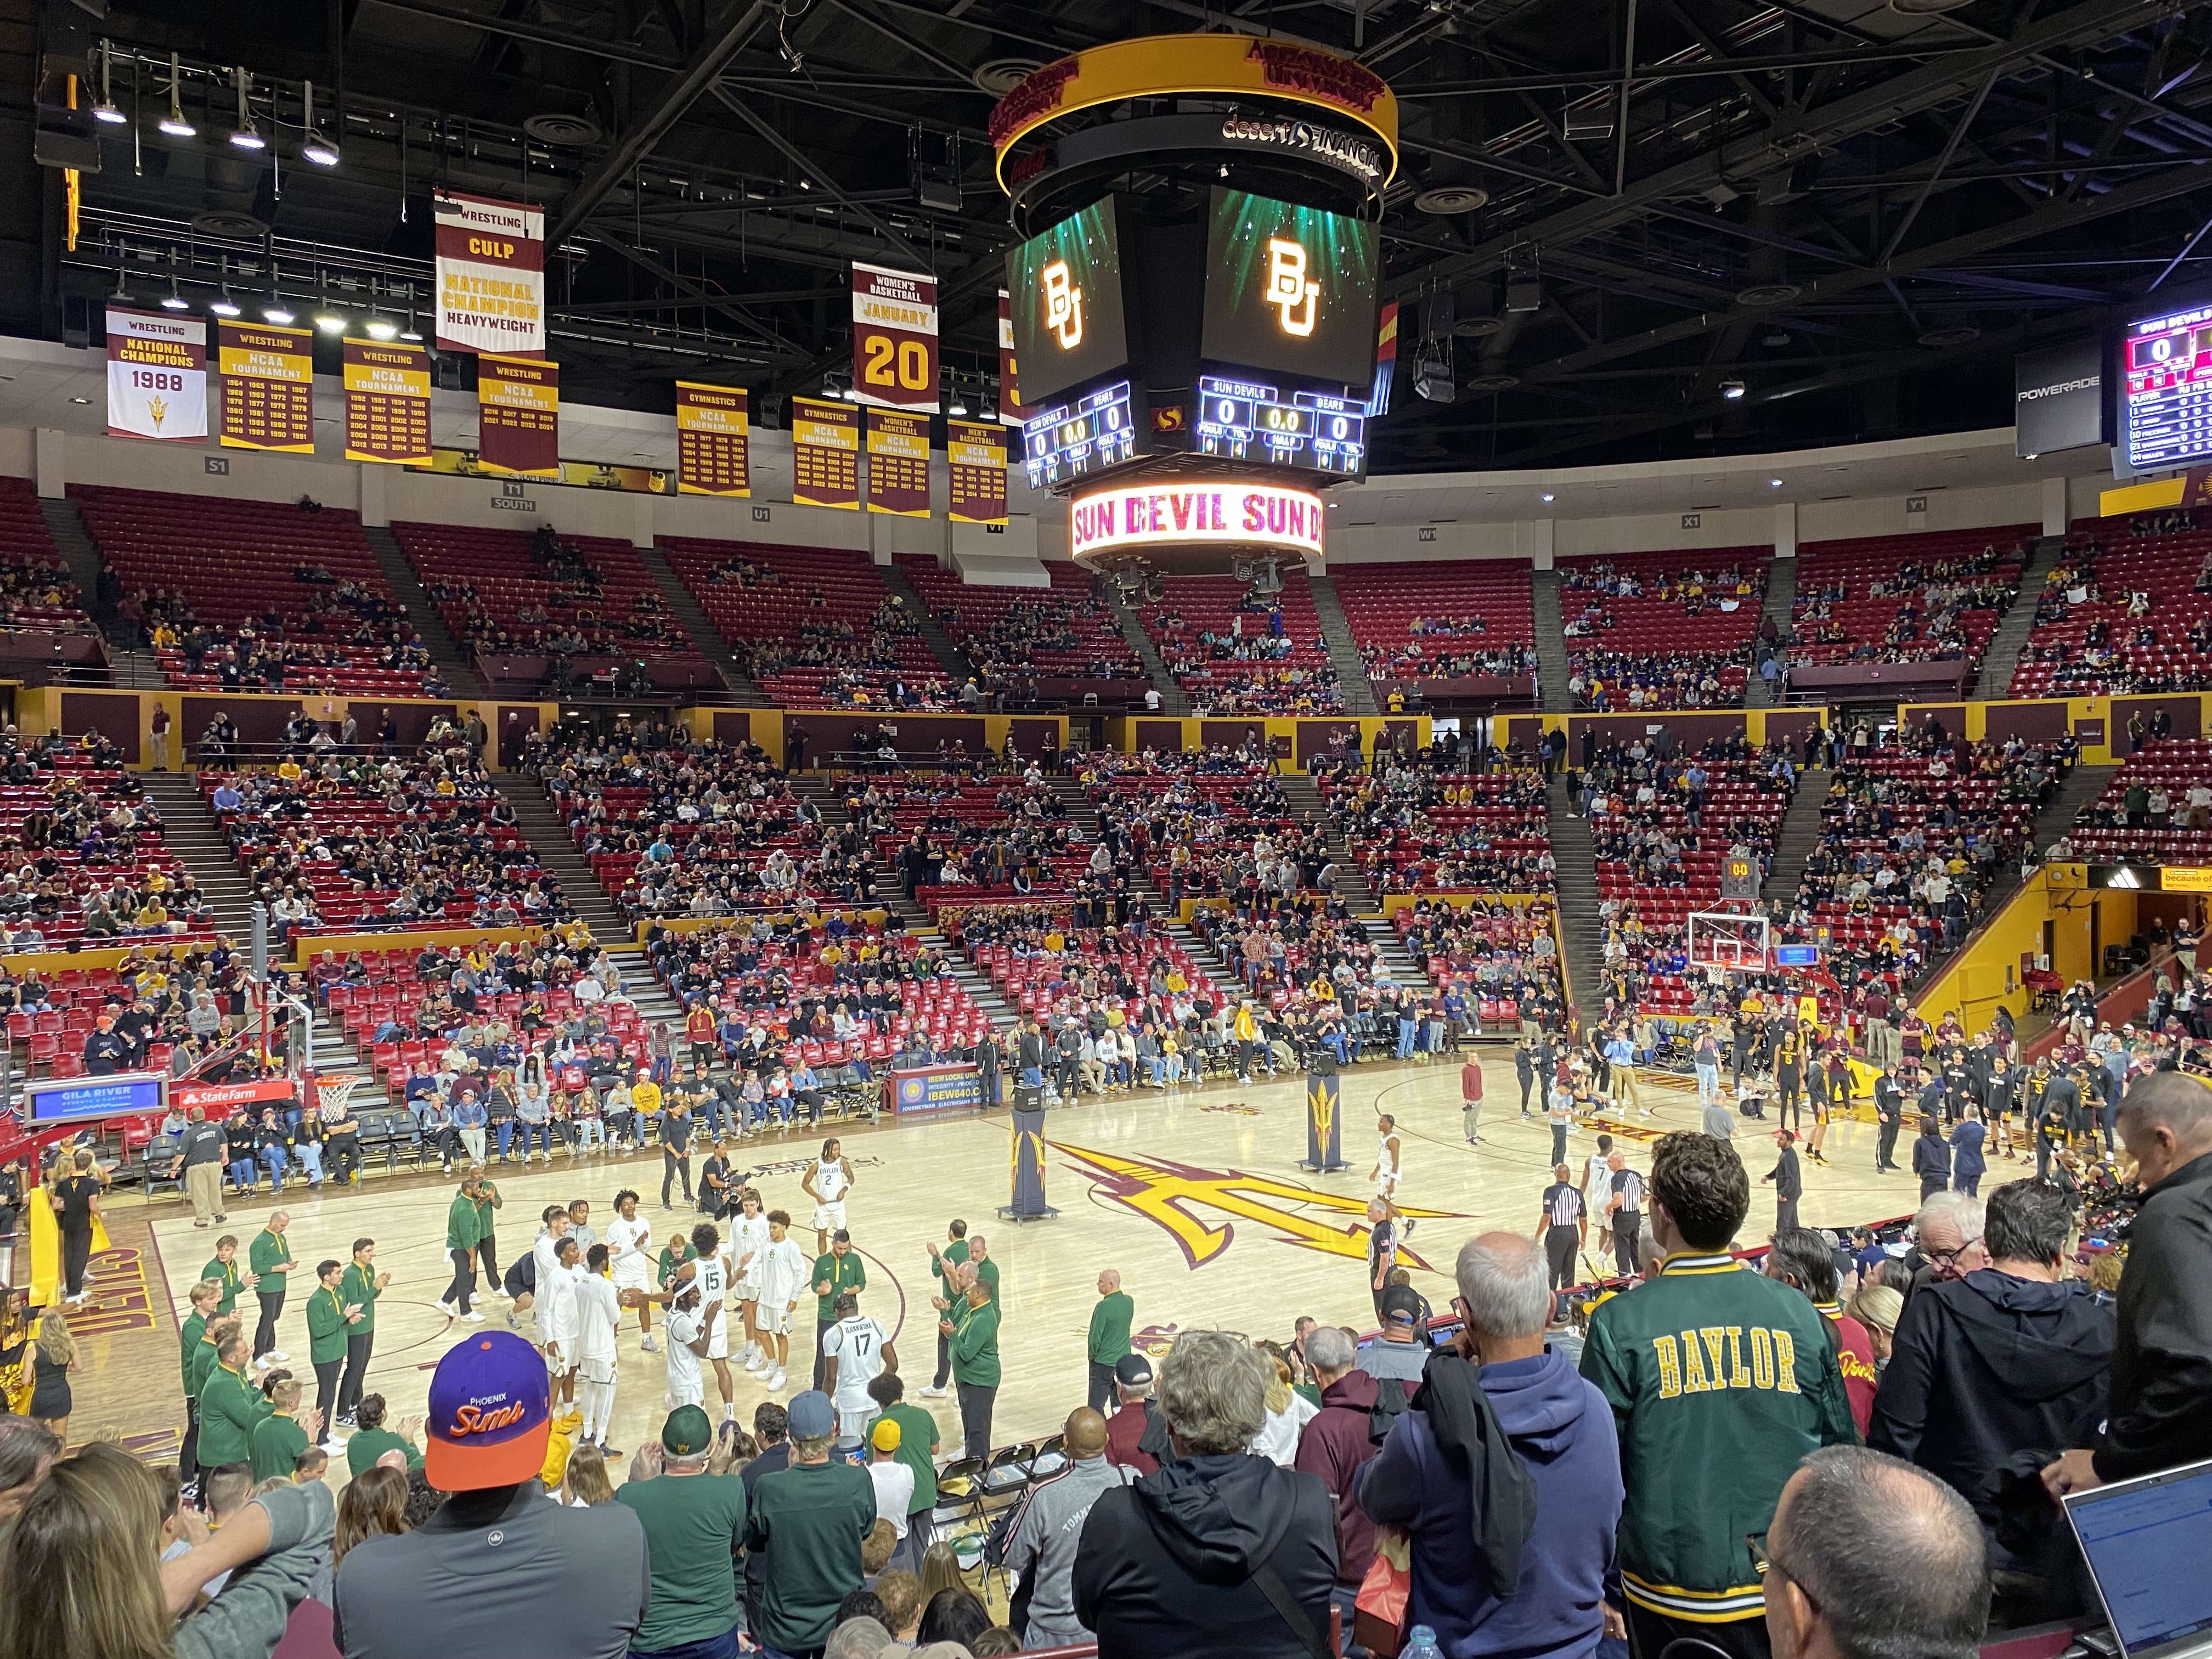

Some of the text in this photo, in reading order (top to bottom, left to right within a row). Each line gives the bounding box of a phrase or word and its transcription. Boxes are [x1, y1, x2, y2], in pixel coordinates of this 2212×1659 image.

[1222, 114, 1380, 176] desert FINANCIAL
[461, 210, 521, 228] WRESTLING
[469, 238, 514, 259] CULP
[445, 273, 534, 301] NATIONAL
[876, 275, 915, 291] WOMEN'S
[1266, 238, 1319, 337] BU
[870, 284, 922, 302] BASKETBALL
[442, 292, 539, 320] CHAMPION
[1042, 261, 1082, 350] BU
[864, 303, 928, 326] JANUARY
[129, 321, 184, 336] WRESTLING
[447, 312, 535, 334] HEAVYWEIGHT
[2141, 320, 2166, 334] SUN
[127, 338, 187, 356] NATIONAL
[240, 334, 292, 348] WRESTLING
[2152, 338, 2170, 361] 0
[120, 349, 194, 367] CHAMPIONS
[250, 353, 284, 367] NCAA
[363, 352, 412, 364] WRESTLING
[865, 335, 928, 391] 20
[232, 364, 301, 379] TOURNAMENT
[373, 370, 404, 382] NCAA
[496, 367, 541, 380] WRESTLING
[132, 370, 182, 391] 1988
[356, 380, 420, 394] TOURNAMENT
[505, 385, 533, 397] NCAA
[1214, 381, 1266, 399] SUN DEVILS
[2018, 376, 2100, 402] POWERADE
[489, 394, 549, 409] TOURNAMENT
[690, 394, 736, 407] GYMNASTICS
[1094, 391, 1113, 407] BEARS
[1317, 398, 1344, 411] BEARS
[2131, 392, 2160, 403] PLAYER
[350, 413, 367, 421] 2000
[700, 411, 726, 422] NCAA
[804, 409, 847, 421] GYMNASTICS
[1218, 399, 1235, 424] 0
[501, 419, 518, 427] 2022
[520, 421, 537, 429] 2023
[538, 422, 555, 431] 2024
[687, 420, 740, 432] TOURNAMENT
[884, 417, 913, 427] WOMEN'S
[1030, 411, 1062, 431] SUN DEVILS
[1108, 407, 1119, 431] 0
[1269, 408, 1299, 431] 0.0
[370, 424, 387, 432] 2005
[814, 426, 838, 437] NCAA
[879, 424, 918, 436] BASKETBALL
[968, 428, 988, 437] MEN'S
[1065, 419, 1086, 443] 0.0
[1199, 424, 1223, 435] FOULS
[1332, 416, 1348, 440] 0
[802, 434, 850, 447] TOURNAMENT
[887, 436, 910, 447] NCAA
[960, 435, 996, 445] BASKETBALL
[1036, 434, 1046, 456] 0
[1272, 436, 1295, 447] HALF
[875, 444, 922, 456] TOURNAMENT
[967, 447, 988, 456] NCAA
[209, 460, 225, 472] S1
[956, 455, 1000, 466] TOURNAMENT
[506, 484, 521, 495] T1
[494, 499, 533, 511] SOUTH
[1910, 500, 1924, 509] Y1
[754, 509, 769, 520] U1
[1075, 493, 1304, 545] SUN DEVIL SUN
[1684, 517, 1699, 527] X1
[1419, 530, 1436, 539] W1
[198, 1015, 215, 1023] ASU
[1785, 1055, 1792, 1065] 5
[928, 1075, 944, 1083] IBEW
[62, 1086, 131, 1101] GILA RIVER
[2035, 1085, 2042, 1094] 3
[902, 1103, 935, 1111] JOURNEYMAN
[826, 1175, 831, 1186] 2
[1598, 1167, 1605, 1181] 7
[706, 1272, 719, 1291] 15
[855, 1333, 871, 1357] 17
[1653, 1326, 1799, 1400] BAYLOR
[470, 1392, 506, 1406] PHOENIX
[449, 1400, 524, 1436] Suns
